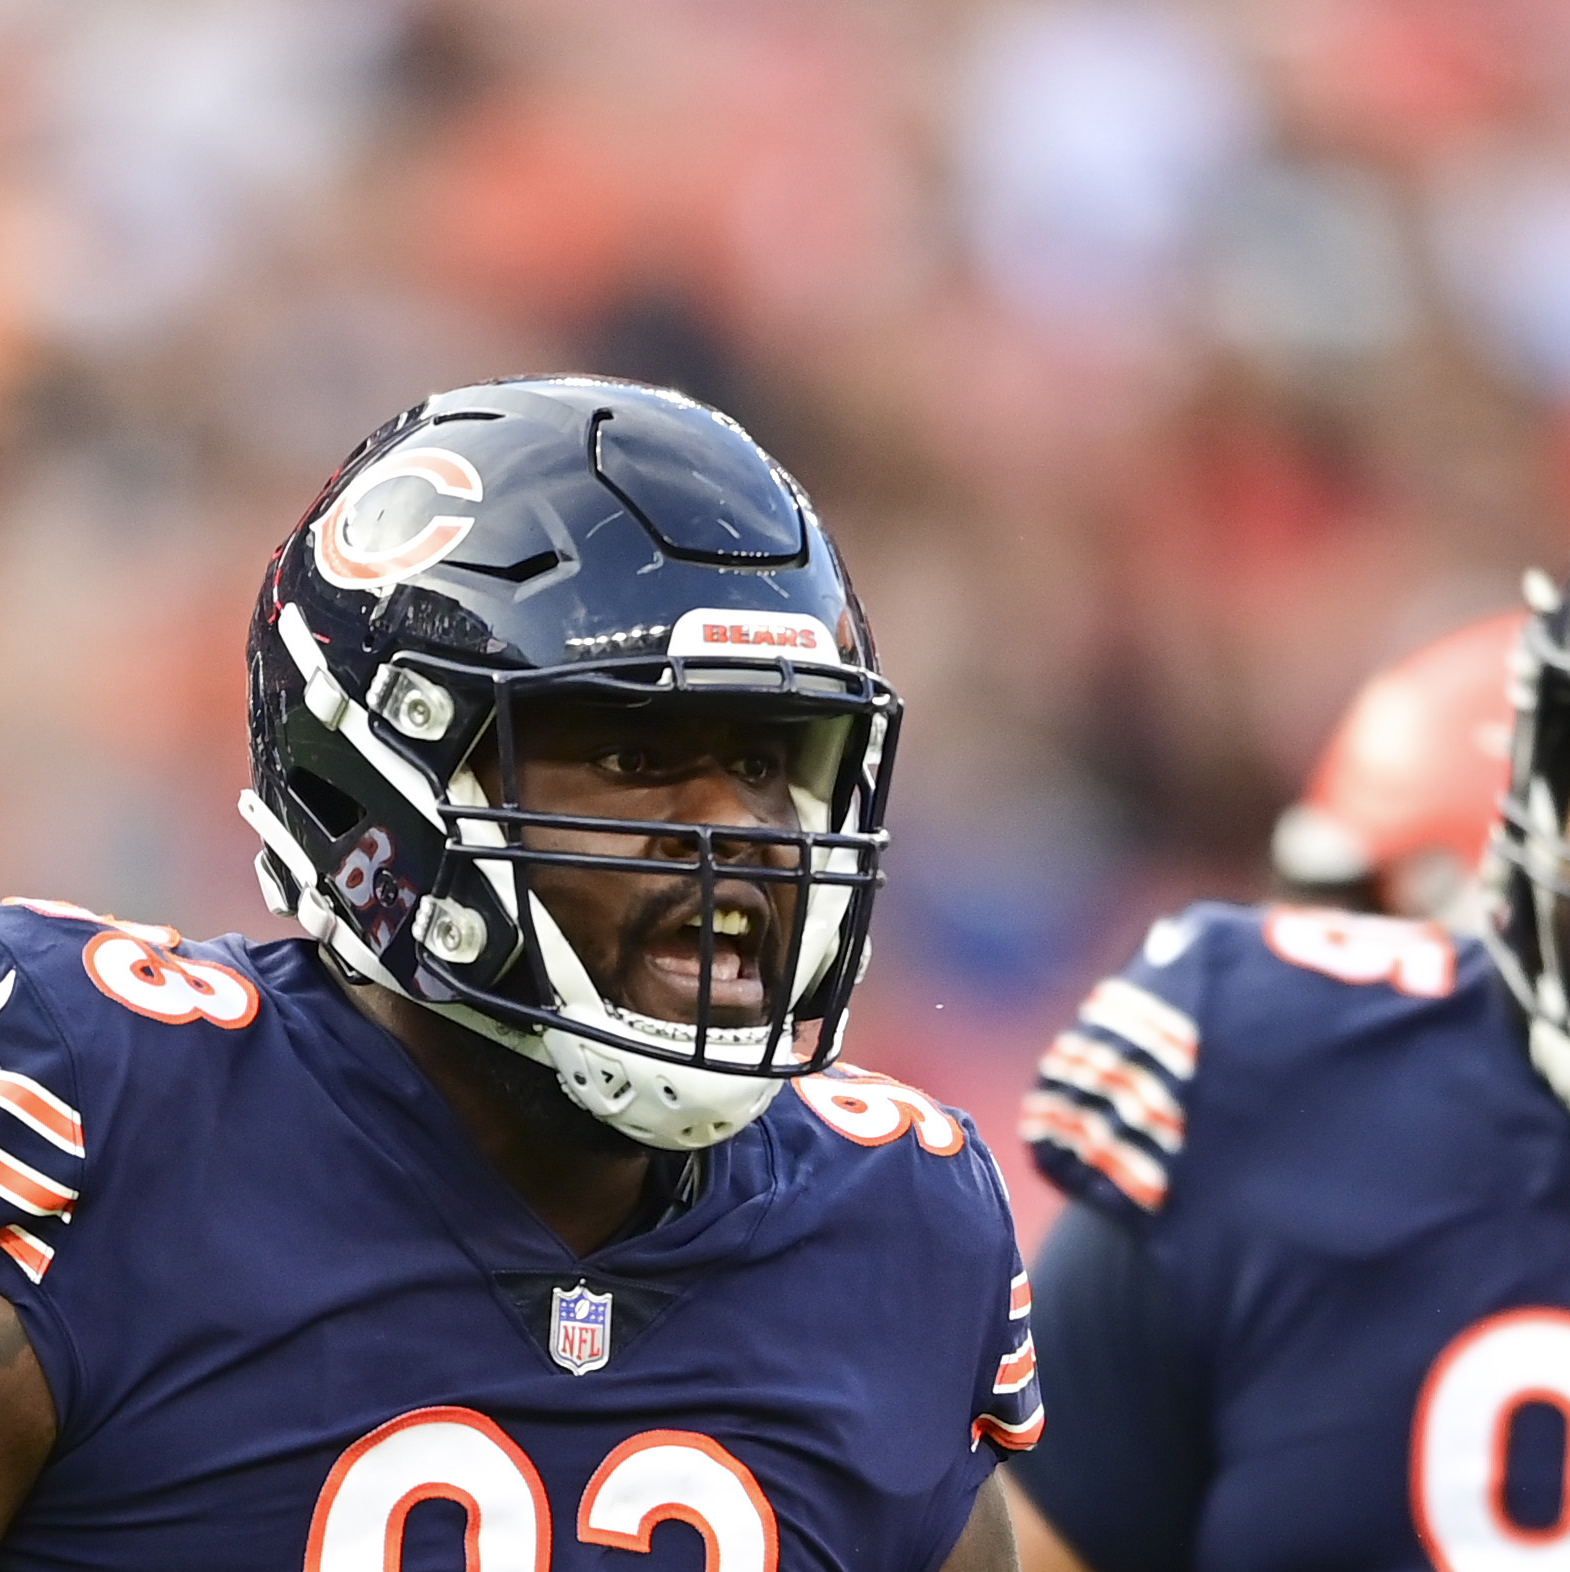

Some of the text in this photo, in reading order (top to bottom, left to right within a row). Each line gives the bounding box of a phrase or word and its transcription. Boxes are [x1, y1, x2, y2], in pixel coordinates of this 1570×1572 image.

[309, 447, 484, 590] C
[702, 624, 818, 649] BEARS
[561, 1325, 600, 1360] NFL
